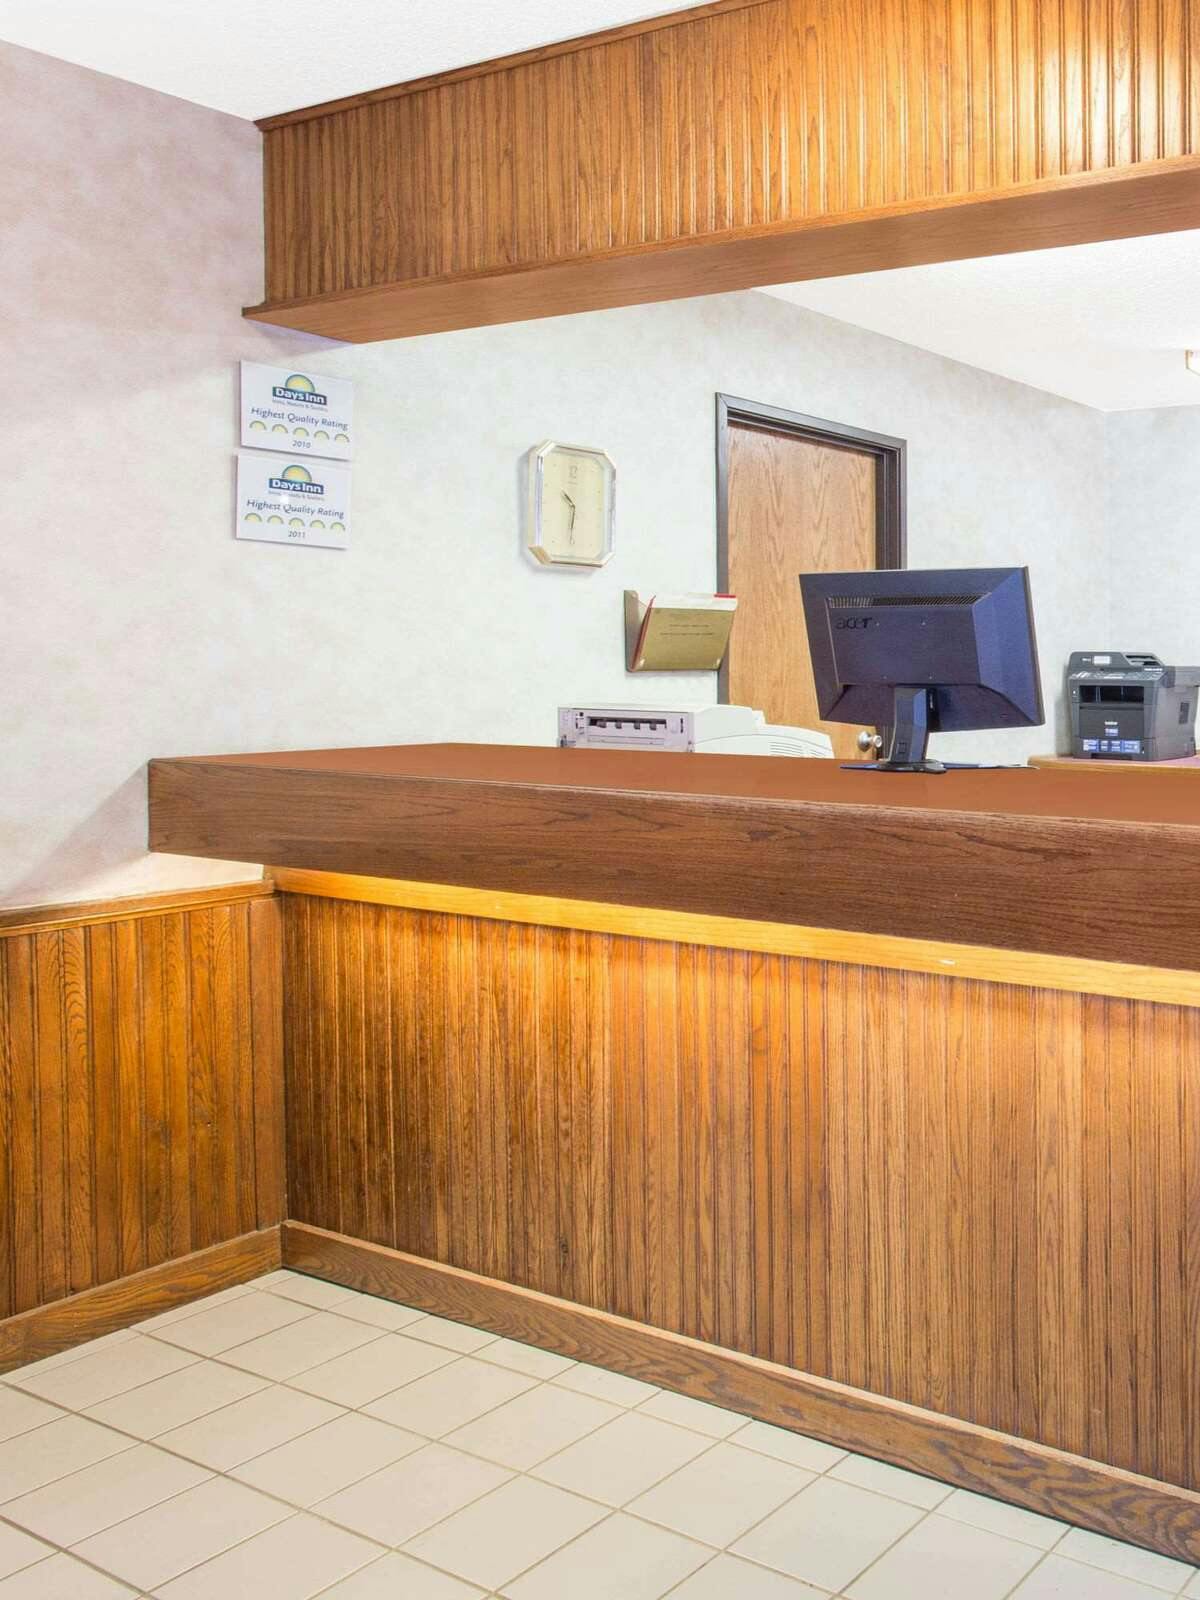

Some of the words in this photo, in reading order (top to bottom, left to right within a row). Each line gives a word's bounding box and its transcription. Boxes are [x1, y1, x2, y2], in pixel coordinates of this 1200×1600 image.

[275, 388, 304, 400] Days
[305, 392, 325, 404] Inn
[250, 406, 286, 420] Highest
[287, 412, 320, 427] Quality
[321, 418, 349, 431] Rating
[292, 439, 311, 449] 2010
[272, 479, 301, 491] Days
[302, 482, 321, 494] Inn
[246, 498, 281, 511] Highest
[282, 503, 316, 516] Quality
[317, 507, 345, 520] Rating
[287, 529, 307, 539] 2011
[835, 616, 873, 630] acer
